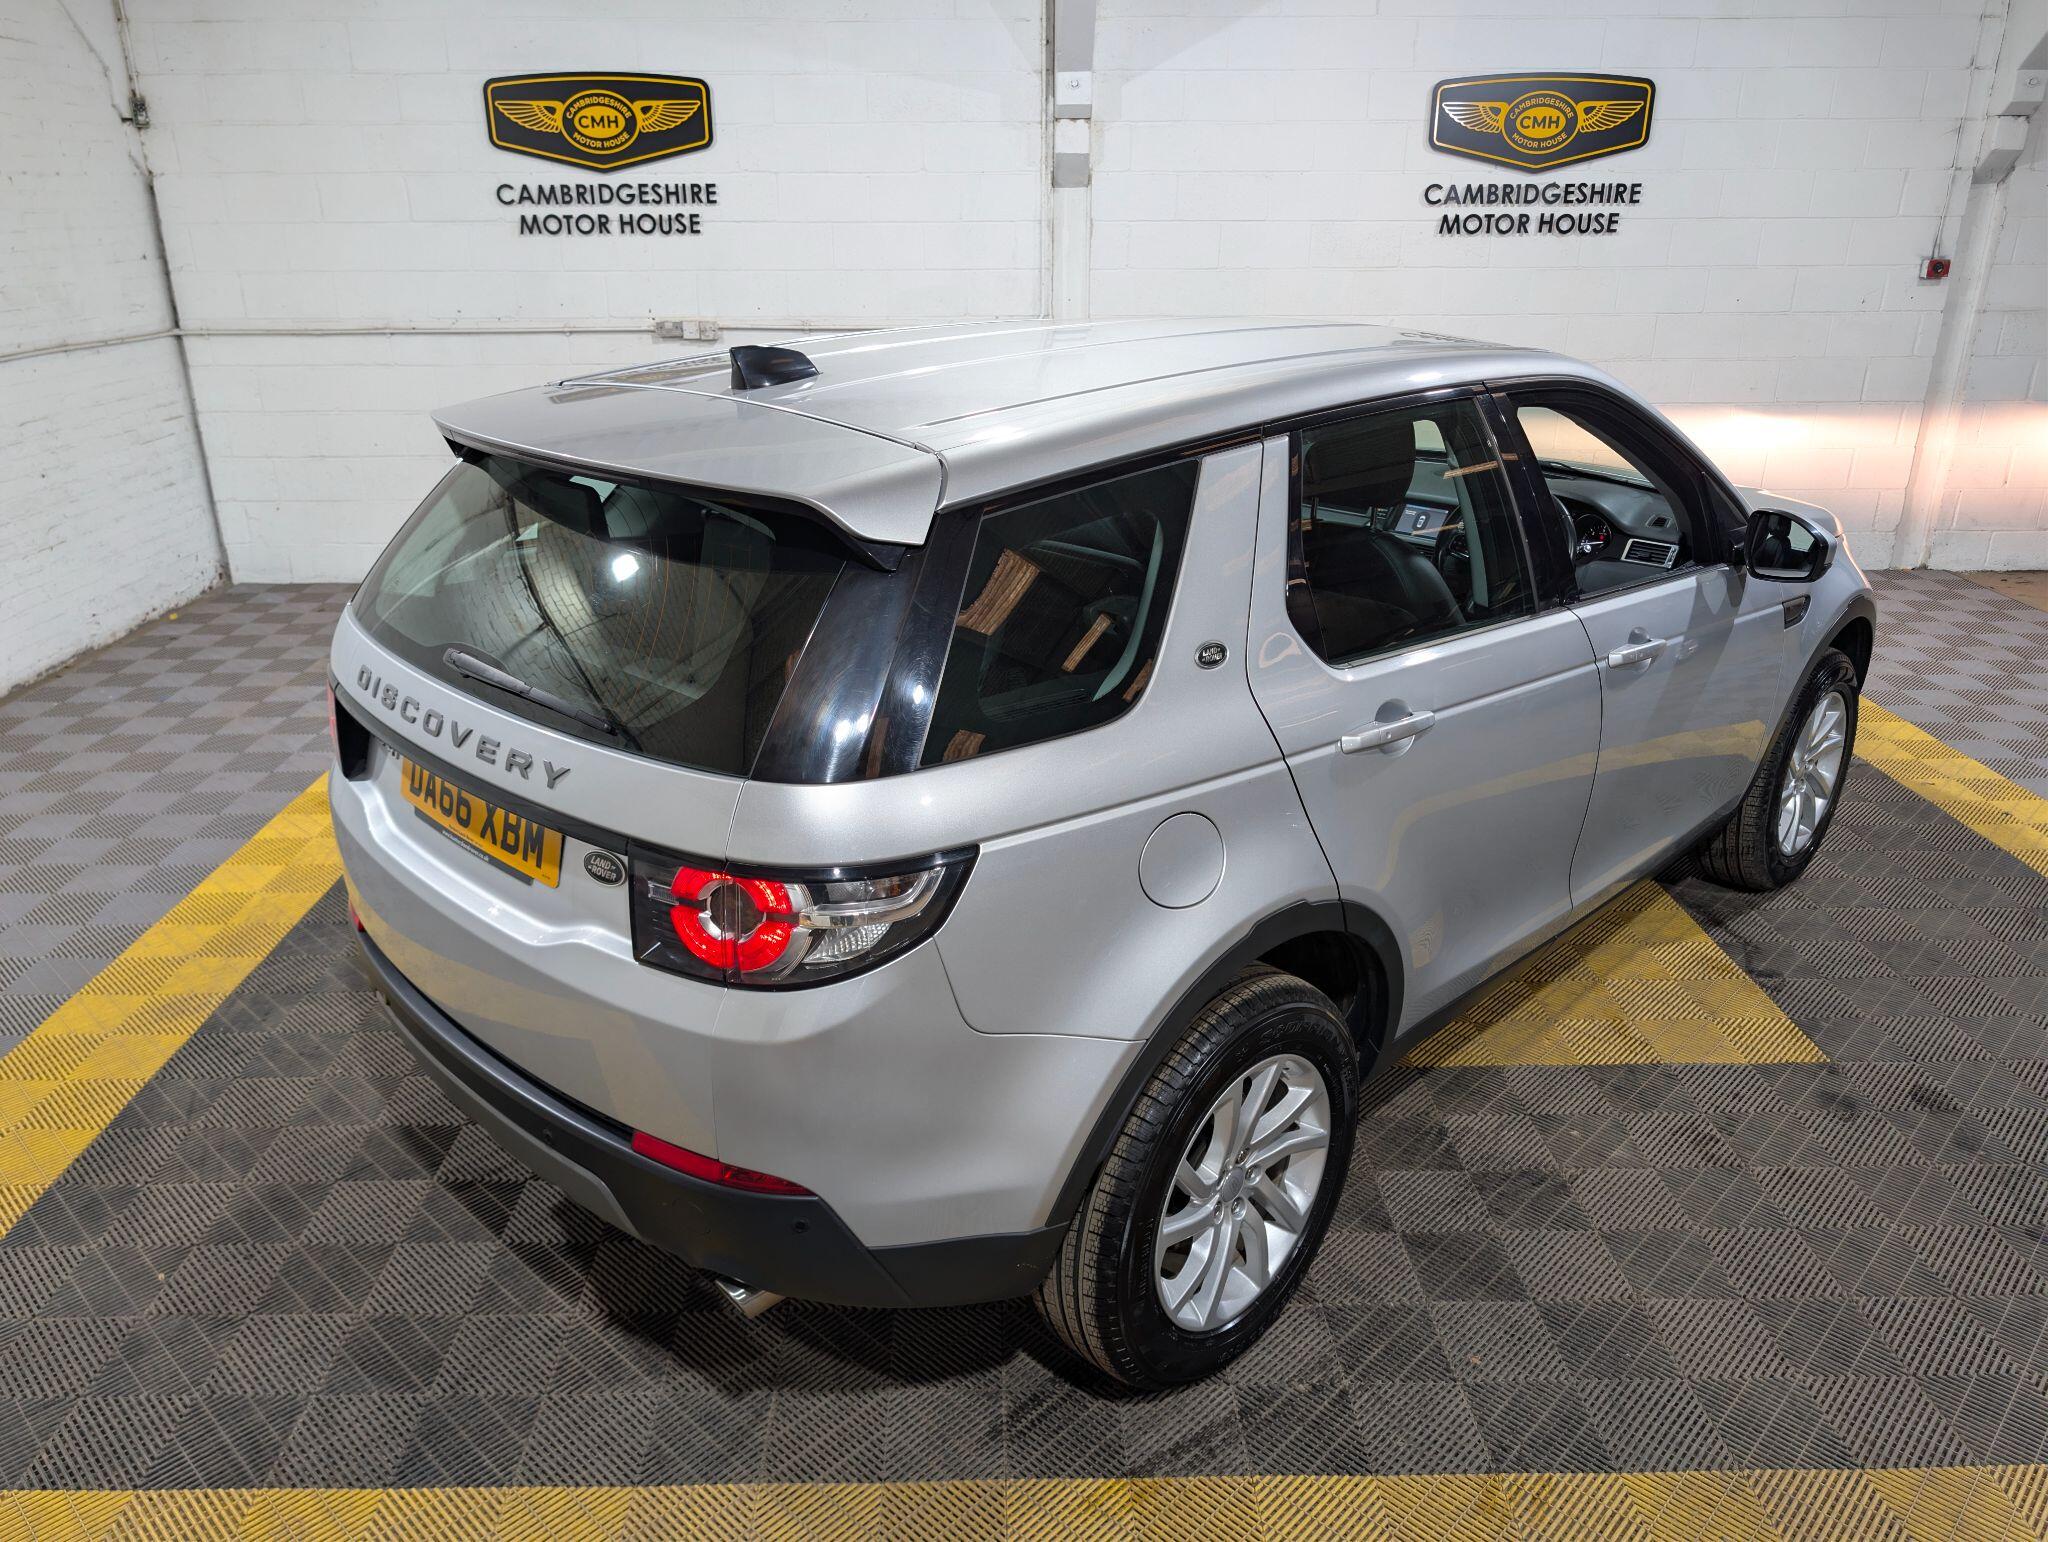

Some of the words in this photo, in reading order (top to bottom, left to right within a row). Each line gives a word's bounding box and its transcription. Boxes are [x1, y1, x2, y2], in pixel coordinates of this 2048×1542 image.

[566, 96, 632, 119] CAMBRIDGESHIRE
[1509, 97, 1574, 120] CAMBRIDGESHIRE
[578, 115, 619, 129] CMH
[1519, 115, 1561, 130] CMH
[572, 132, 602, 148] MOTOR
[603, 132, 630, 148] HOUSE
[1511, 132, 1539, 148] MOTOR
[1540, 132, 1568, 148] HOUSE
[496, 183, 718, 205] CAMBRIDGESHIRE
[1424, 183, 1642, 205] CAMBRIDGESHIRE
[520, 214, 611, 235] MOTOR
[619, 213, 702, 235] HOUSE
[1438, 213, 1530, 235] MOTOR
[1538, 213, 1620, 235] HOUSE
[356, 664, 571, 790] DISCOVERY
[409, 763, 472, 829] DA66
[479, 800, 545, 870] XBM
[590, 855, 612, 870] LAND
[591, 865, 617, 881] ROVER
